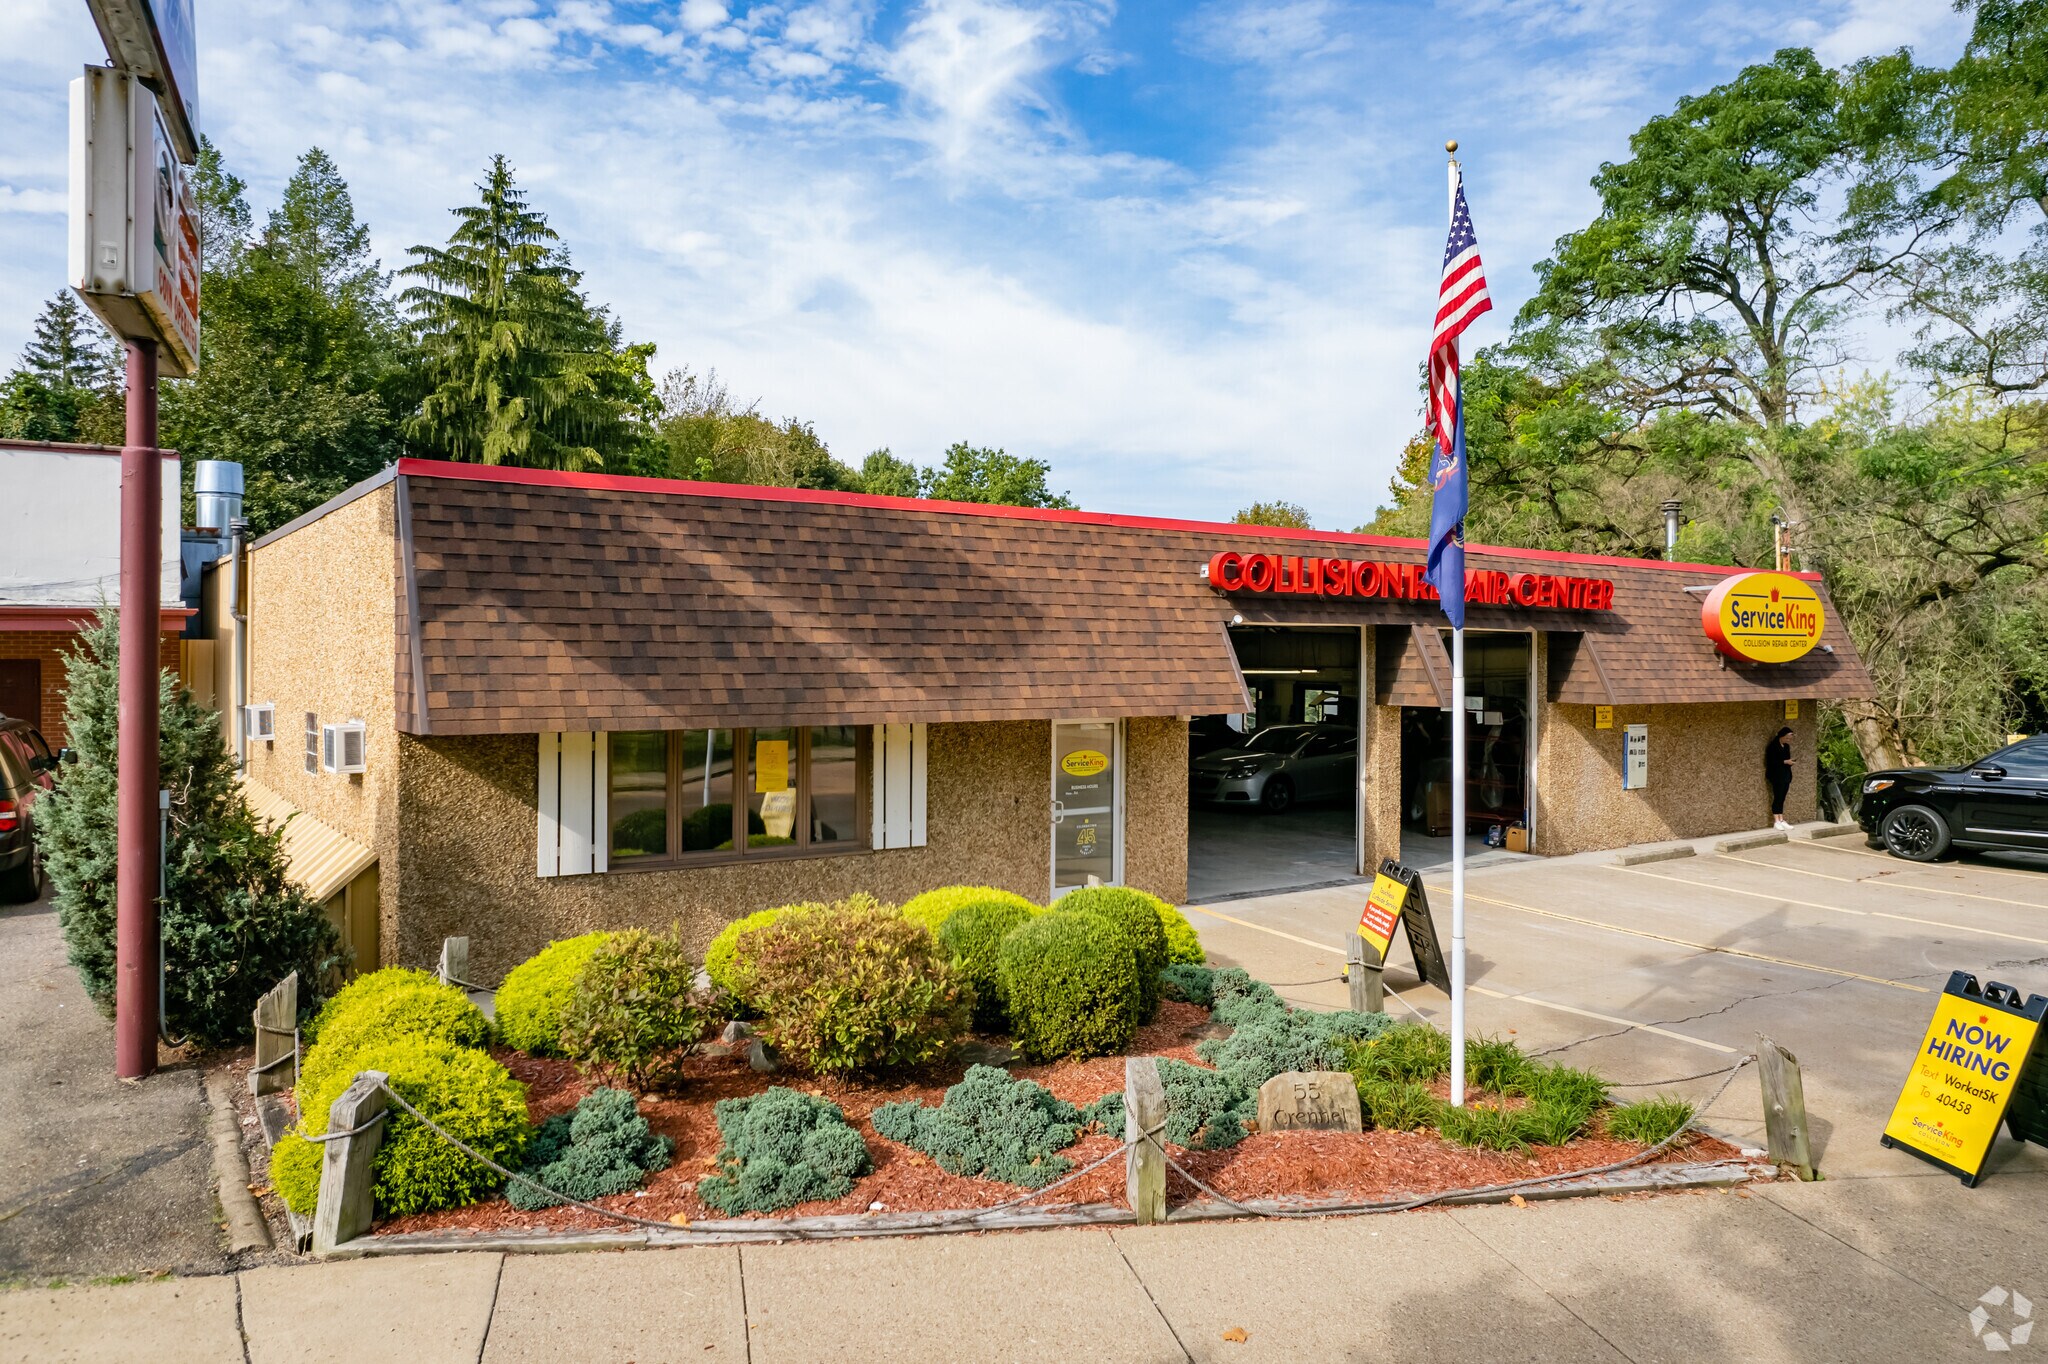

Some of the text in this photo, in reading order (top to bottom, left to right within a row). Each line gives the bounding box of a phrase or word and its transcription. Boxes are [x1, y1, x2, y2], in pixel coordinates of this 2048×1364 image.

[1208, 551, 1615, 610] COLLISION RAIR CENTER
[1731, 600, 1816, 637] ServiceKing
[1772, 640, 1788, 648] REPAIR
[1790, 640, 1807, 648] CENTER
[1077, 828, 1096, 845] 45
[1945, 1018, 2012, 1054] NOW
[1927, 1037, 2011, 1082] HIRING
[1294, 1083, 1321, 1100] 55
[1920, 1064, 1999, 1104] Text WorkatSK
[1920, 1085, 1972, 1115] To 40458
[1918, 1130, 1951, 1148] COLLISION
